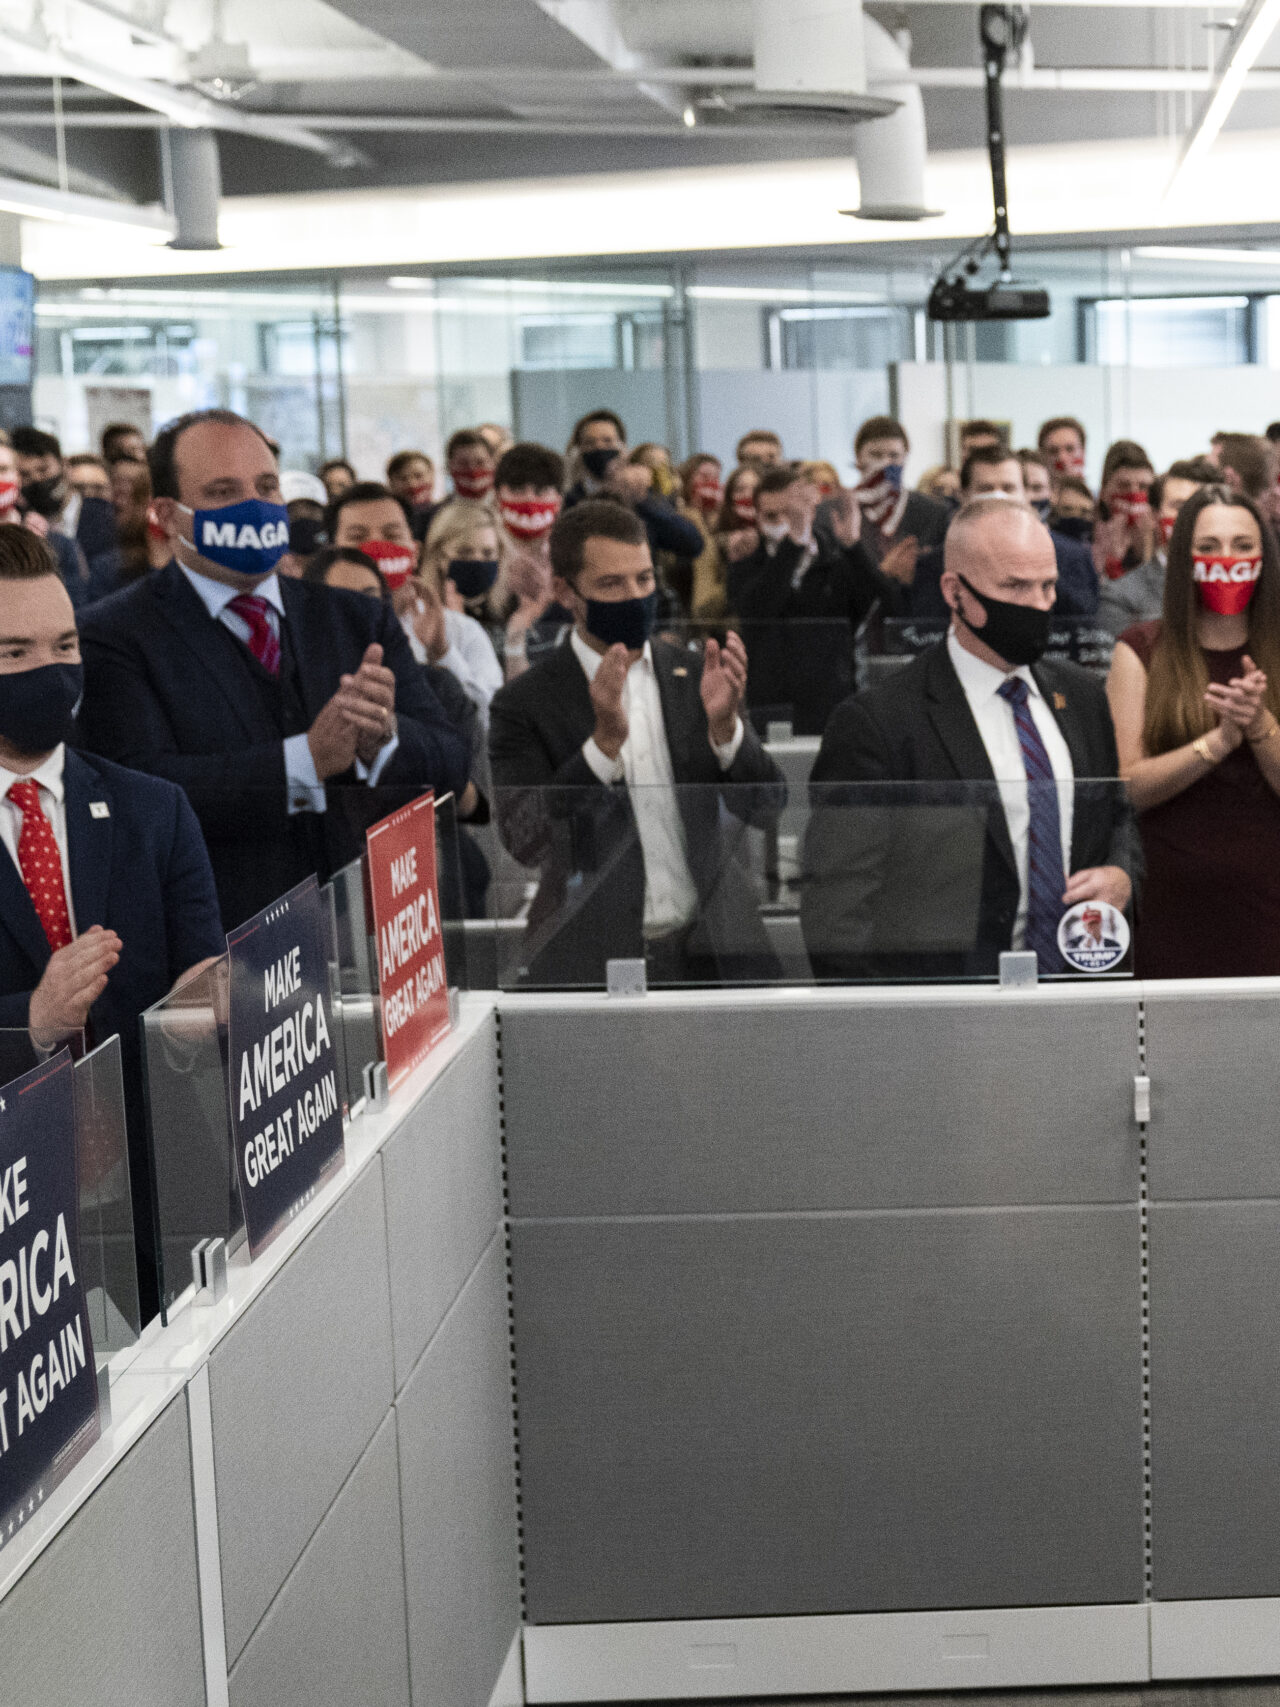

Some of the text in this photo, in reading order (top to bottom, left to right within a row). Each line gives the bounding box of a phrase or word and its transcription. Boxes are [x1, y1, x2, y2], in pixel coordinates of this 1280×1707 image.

[202, 520, 290, 551] MAGA
[390, 845, 419, 898] MAKE
[382, 887, 439, 983] AMERICA
[1073, 952, 1117, 962] TRUMP
[264, 945, 302, 1013] MAKE
[385, 952, 445, 1038] GREAT AGAIN
[239, 992, 331, 1122] AMERICA
[243, 1069, 338, 1188] GREAT AGAIN
[18, 1313, 87, 1437] AGAIN
